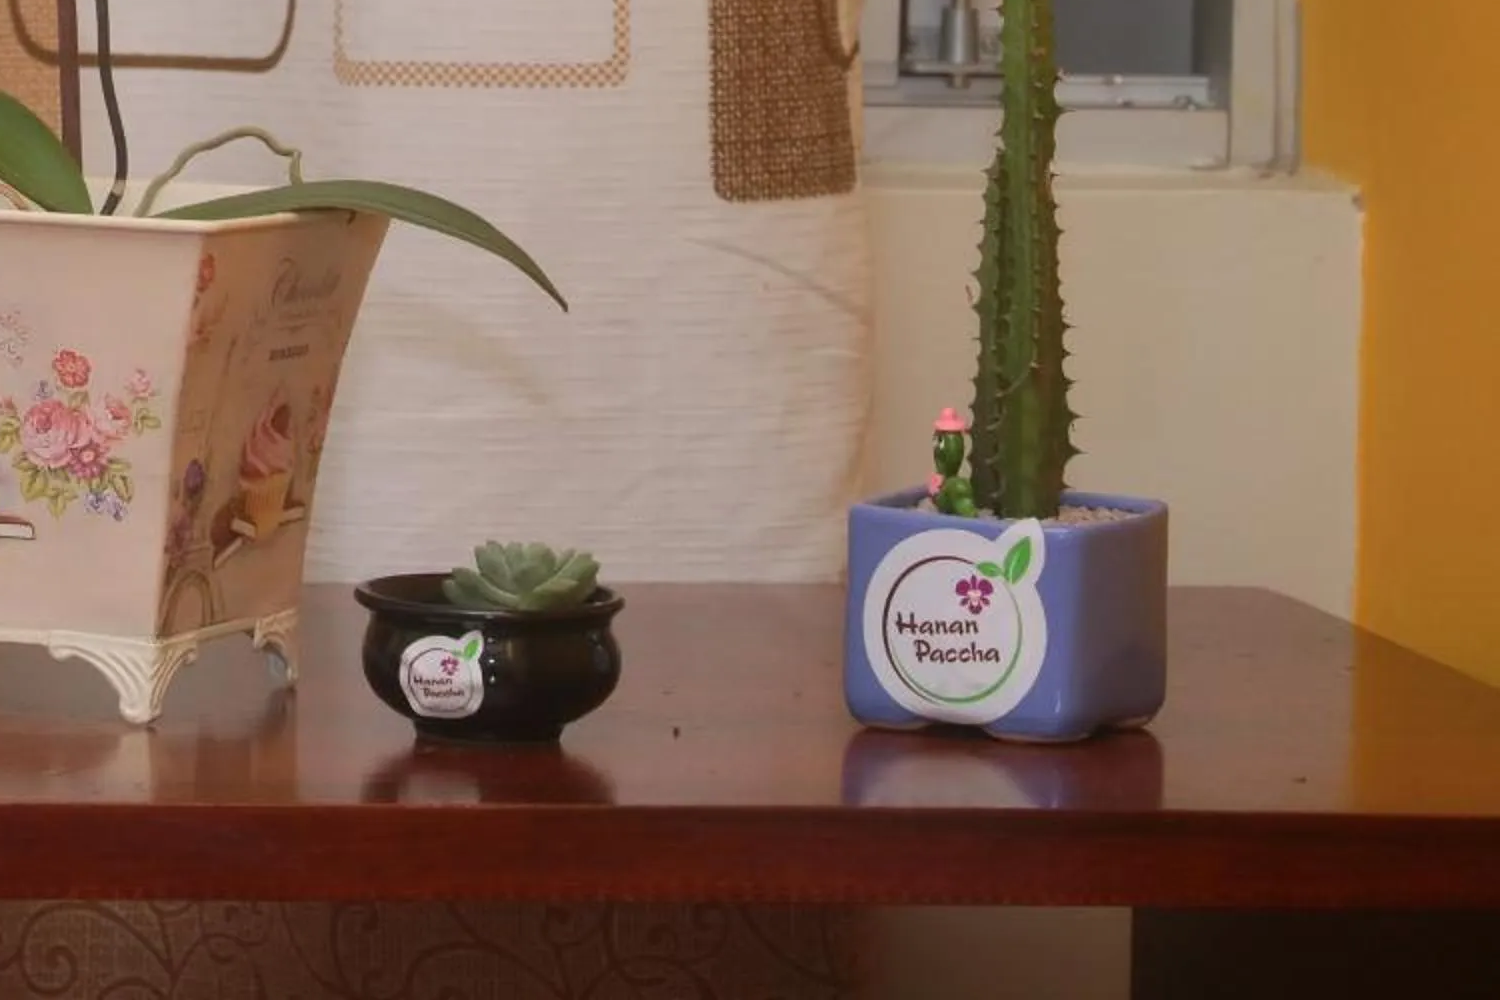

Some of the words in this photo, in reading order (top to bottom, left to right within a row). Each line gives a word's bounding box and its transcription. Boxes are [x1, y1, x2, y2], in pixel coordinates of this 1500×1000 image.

[895, 611, 979, 636] Hanan
[913, 638, 1001, 664] Paccha
[413, 675, 453, 686] Hanan
